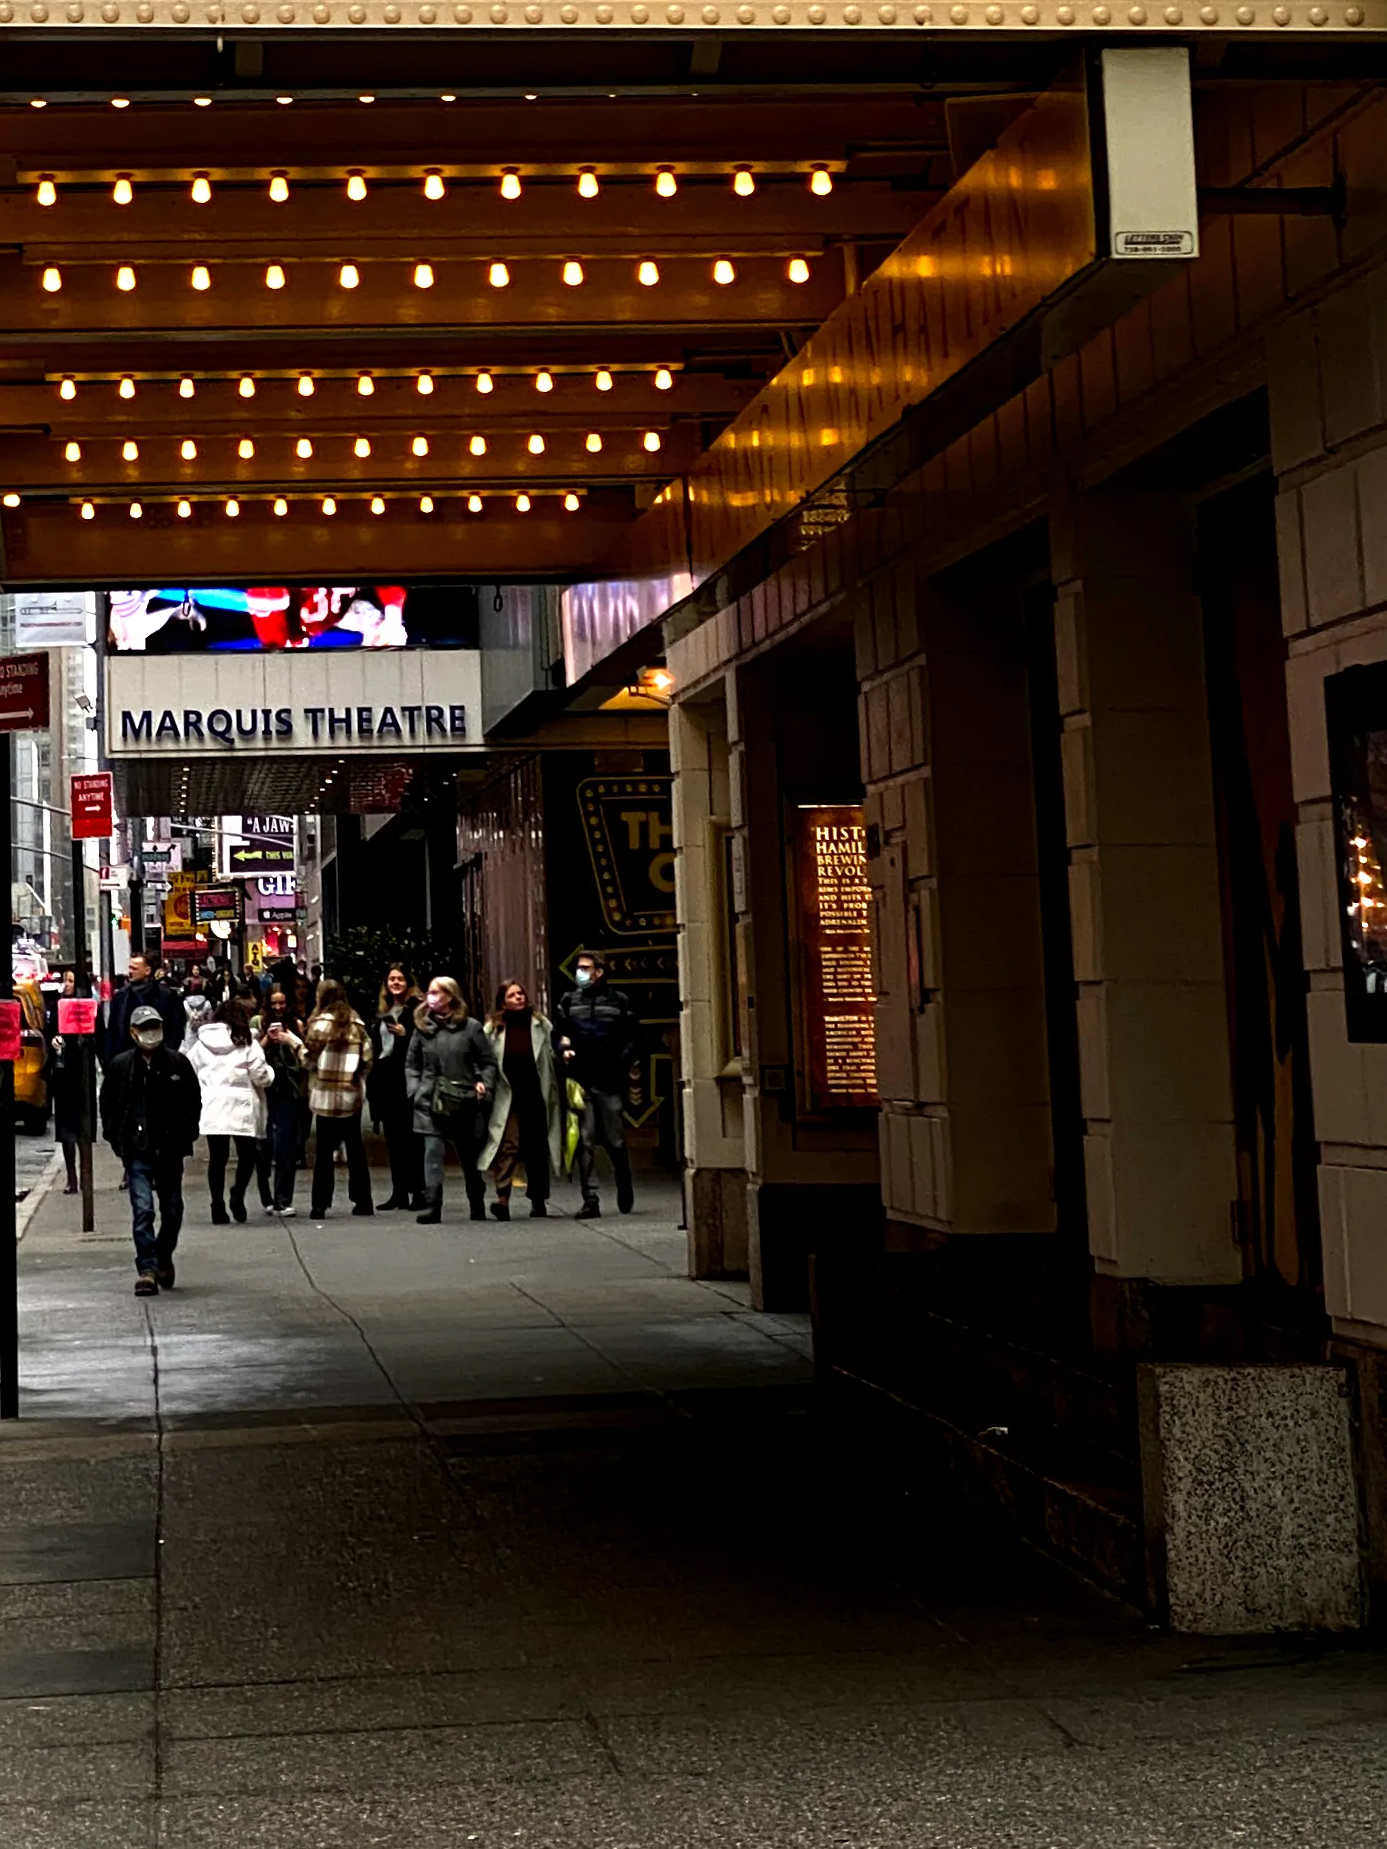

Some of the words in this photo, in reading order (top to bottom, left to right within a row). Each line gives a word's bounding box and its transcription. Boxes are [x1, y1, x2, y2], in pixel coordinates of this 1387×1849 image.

[6, 662, 39, 679] STANDING
[121, 709, 293, 744] MARQUIS
[304, 705, 466, 738] THEATRE
[74, 781, 82, 790] NO
[83, 779, 108, 790] STANDING
[78, 792, 104, 802] ANYTIME
